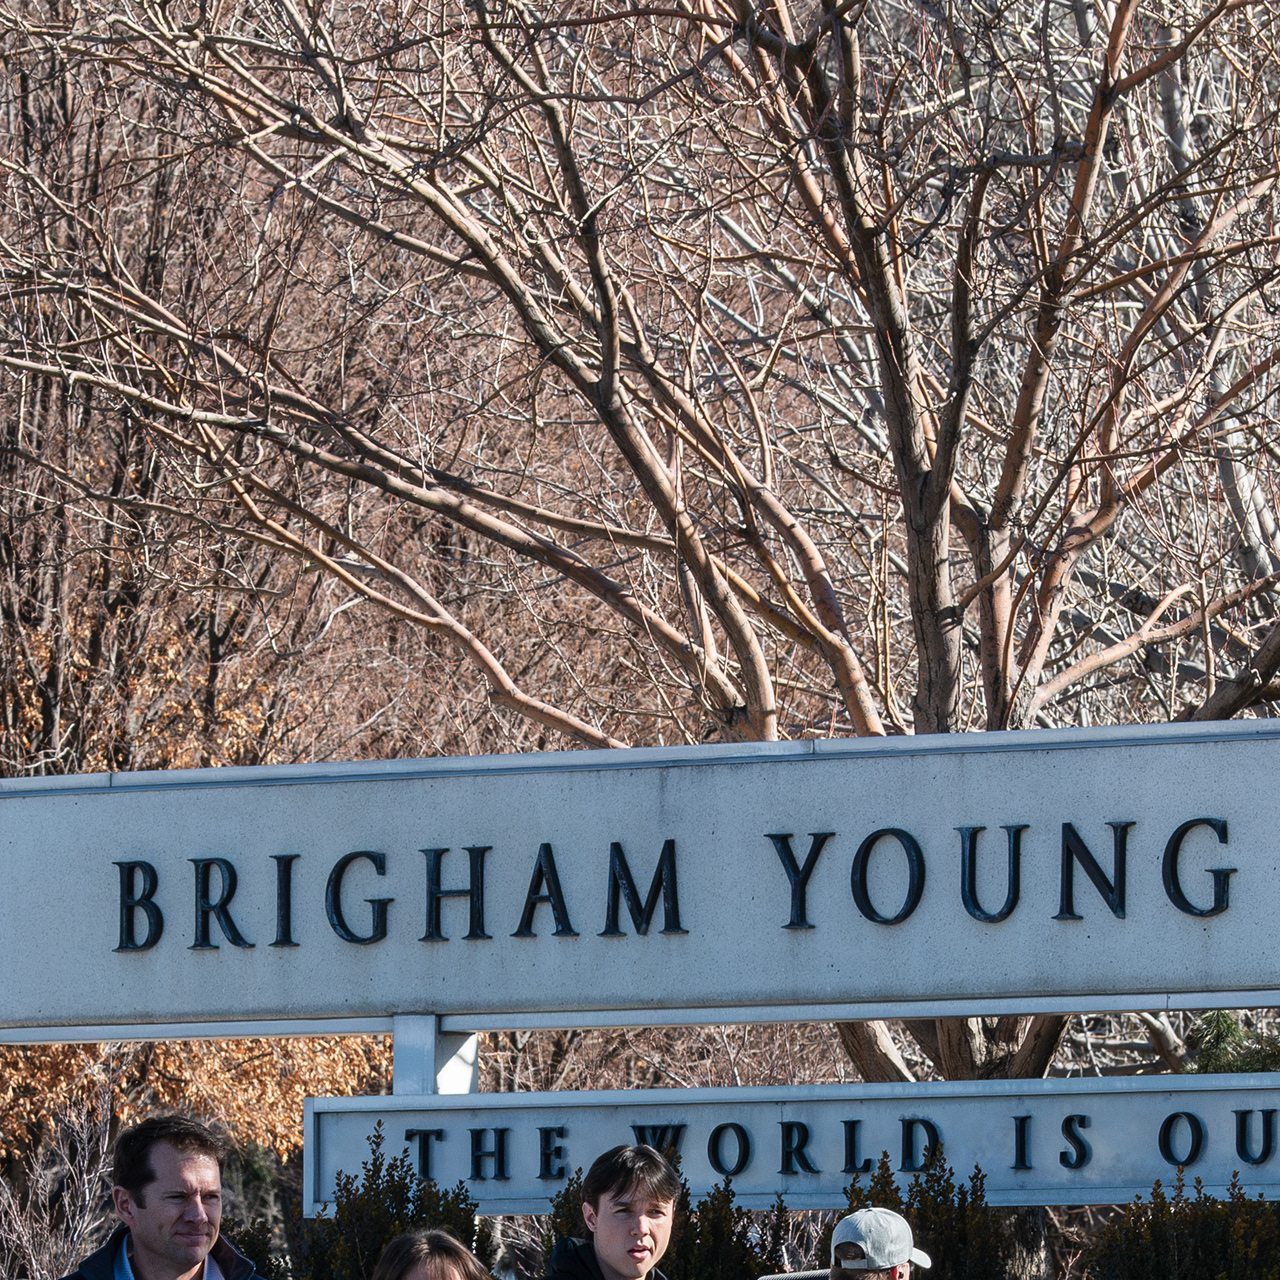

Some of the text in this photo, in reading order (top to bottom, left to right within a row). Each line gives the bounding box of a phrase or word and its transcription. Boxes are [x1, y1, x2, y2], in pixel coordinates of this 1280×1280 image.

[111, 837, 690, 955] BRIGHAM
[763, 816, 1238, 932] YOUNG
[404, 1126, 568, 1181] THE
[1010, 1113, 1090, 1172] IS
